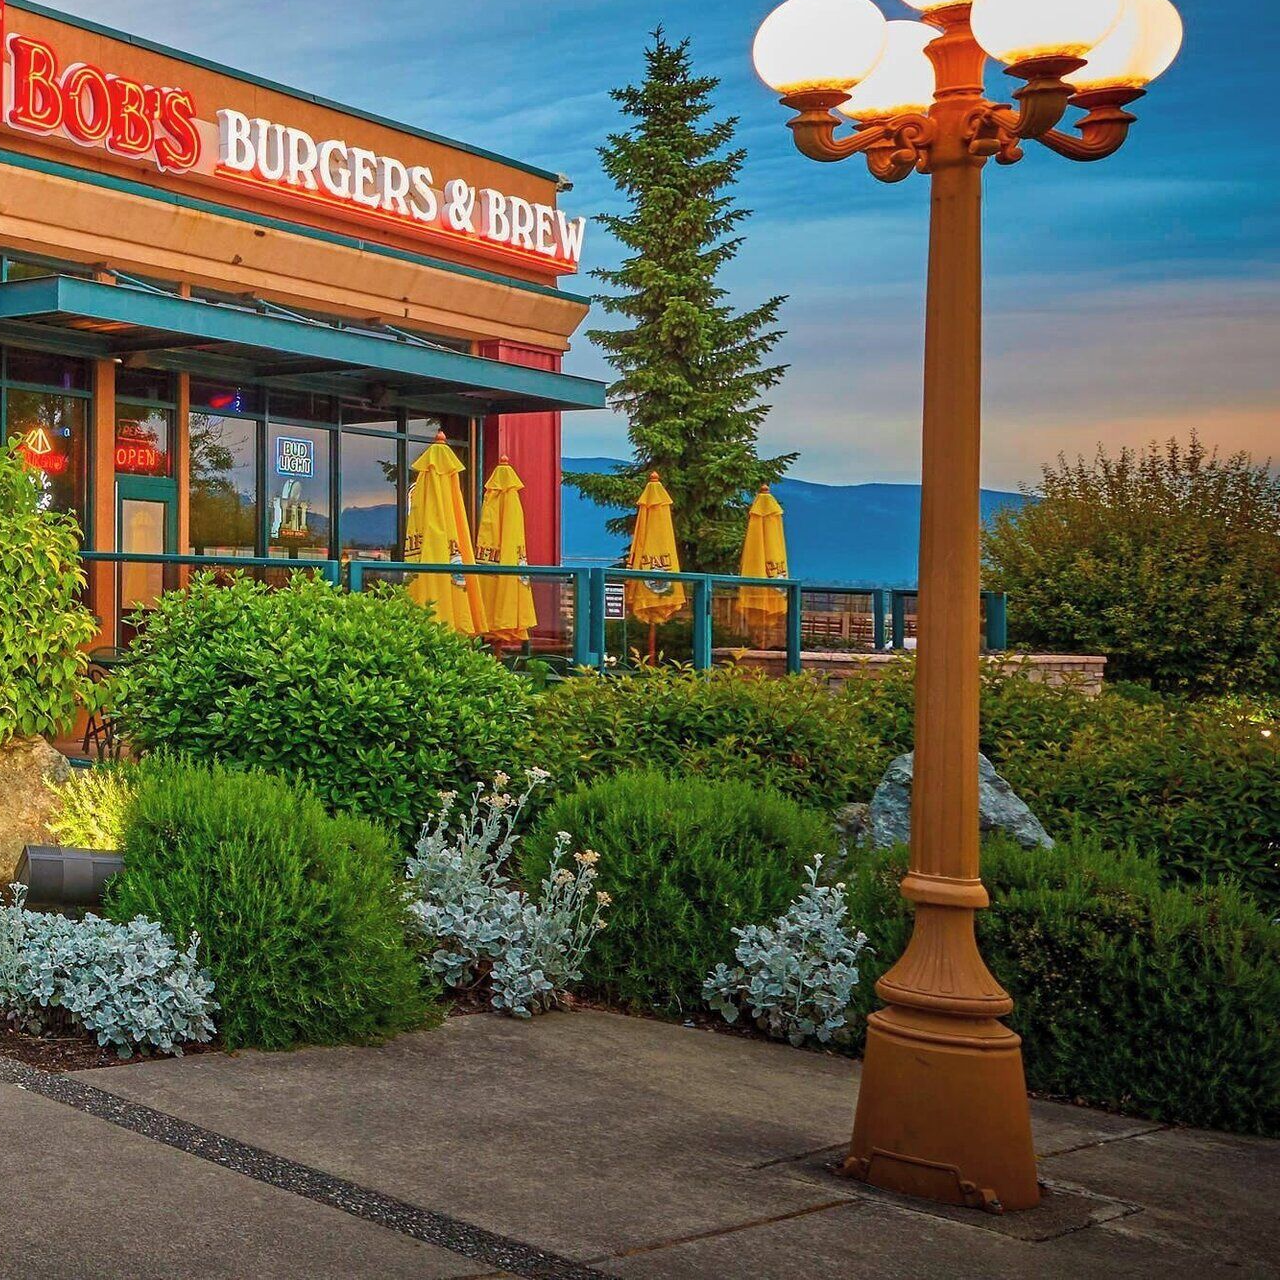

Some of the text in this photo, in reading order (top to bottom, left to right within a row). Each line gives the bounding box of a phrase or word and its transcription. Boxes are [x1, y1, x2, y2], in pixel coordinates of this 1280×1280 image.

[6, 33, 586, 262] BOB'S BURGERS & BREW
[116, 449, 156, 466] OPEN
[284, 441, 307, 458] BUD
[279, 455, 311, 474] LIGHT
